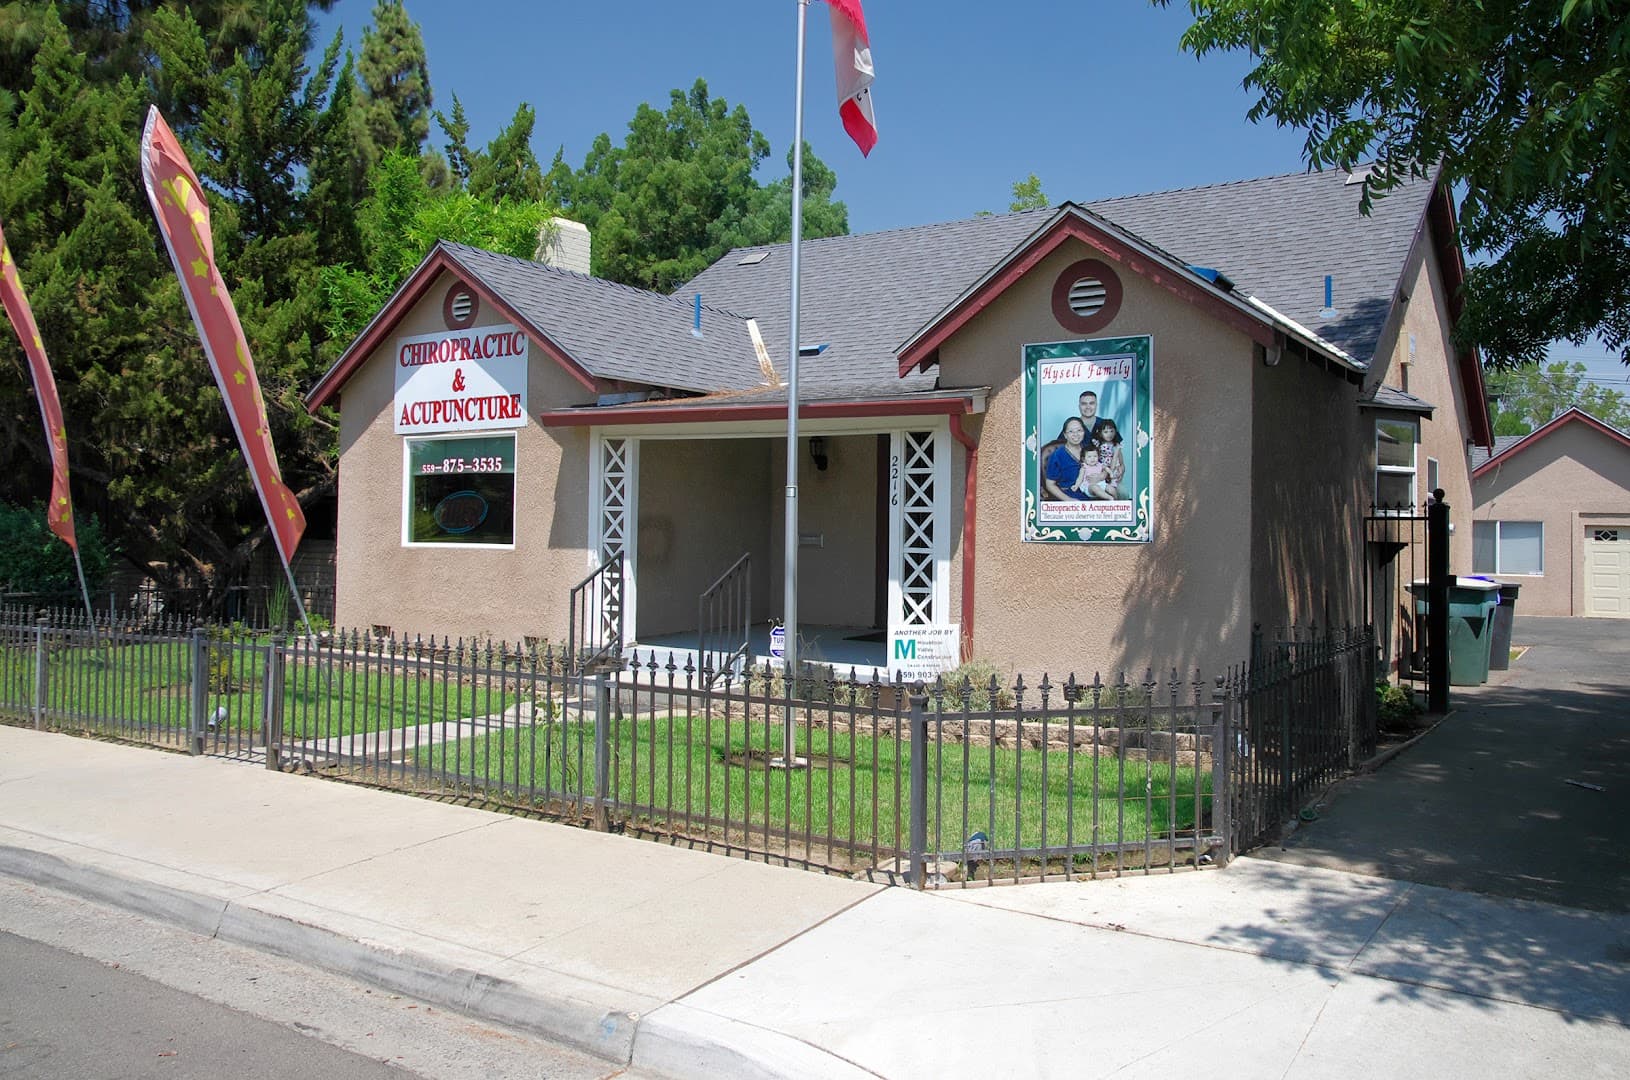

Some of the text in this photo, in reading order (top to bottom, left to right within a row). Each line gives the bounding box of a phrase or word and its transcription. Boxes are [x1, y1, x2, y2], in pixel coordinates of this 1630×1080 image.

[400, 331, 526, 368] CHIROPRACTIC
[452, 368, 466, 392] &
[1043, 360, 1130, 383] Hysell Family
[400, 394, 522, 426] ACUPUNCTURE
[422, 457, 502, 473] 559-875-3535
[1042, 503, 1080, 513] Chiropractic
[1089, 504, 1131, 513] Acupuncture
[895, 639, 916, 660] M
